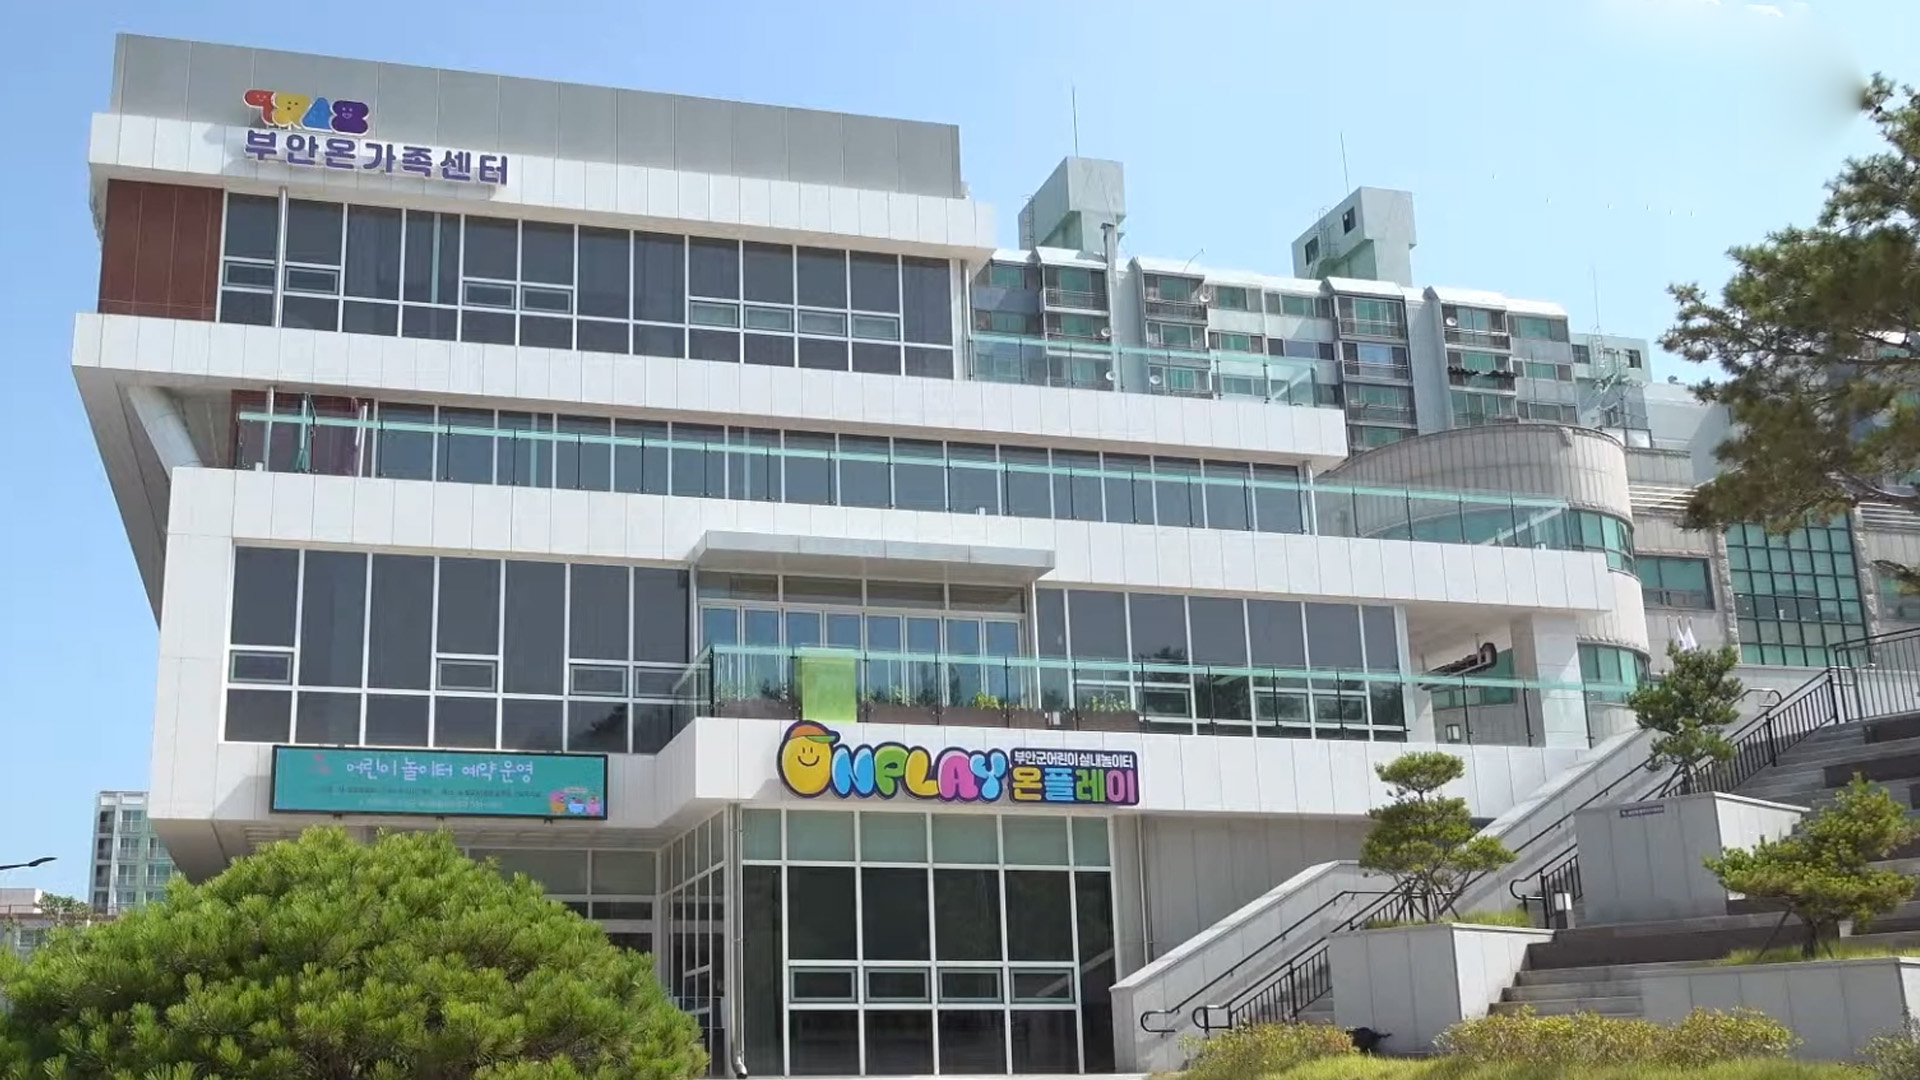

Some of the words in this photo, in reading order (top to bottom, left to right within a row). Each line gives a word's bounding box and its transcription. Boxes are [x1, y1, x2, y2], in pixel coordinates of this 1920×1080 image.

[347, 758, 397, 780] 어린이
[401, 757, 453, 781] 놀이터
[462, 760, 497, 782] 예약
[499, 760, 533, 783] 운영
[1012, 766, 1136, 803] 온플레이
